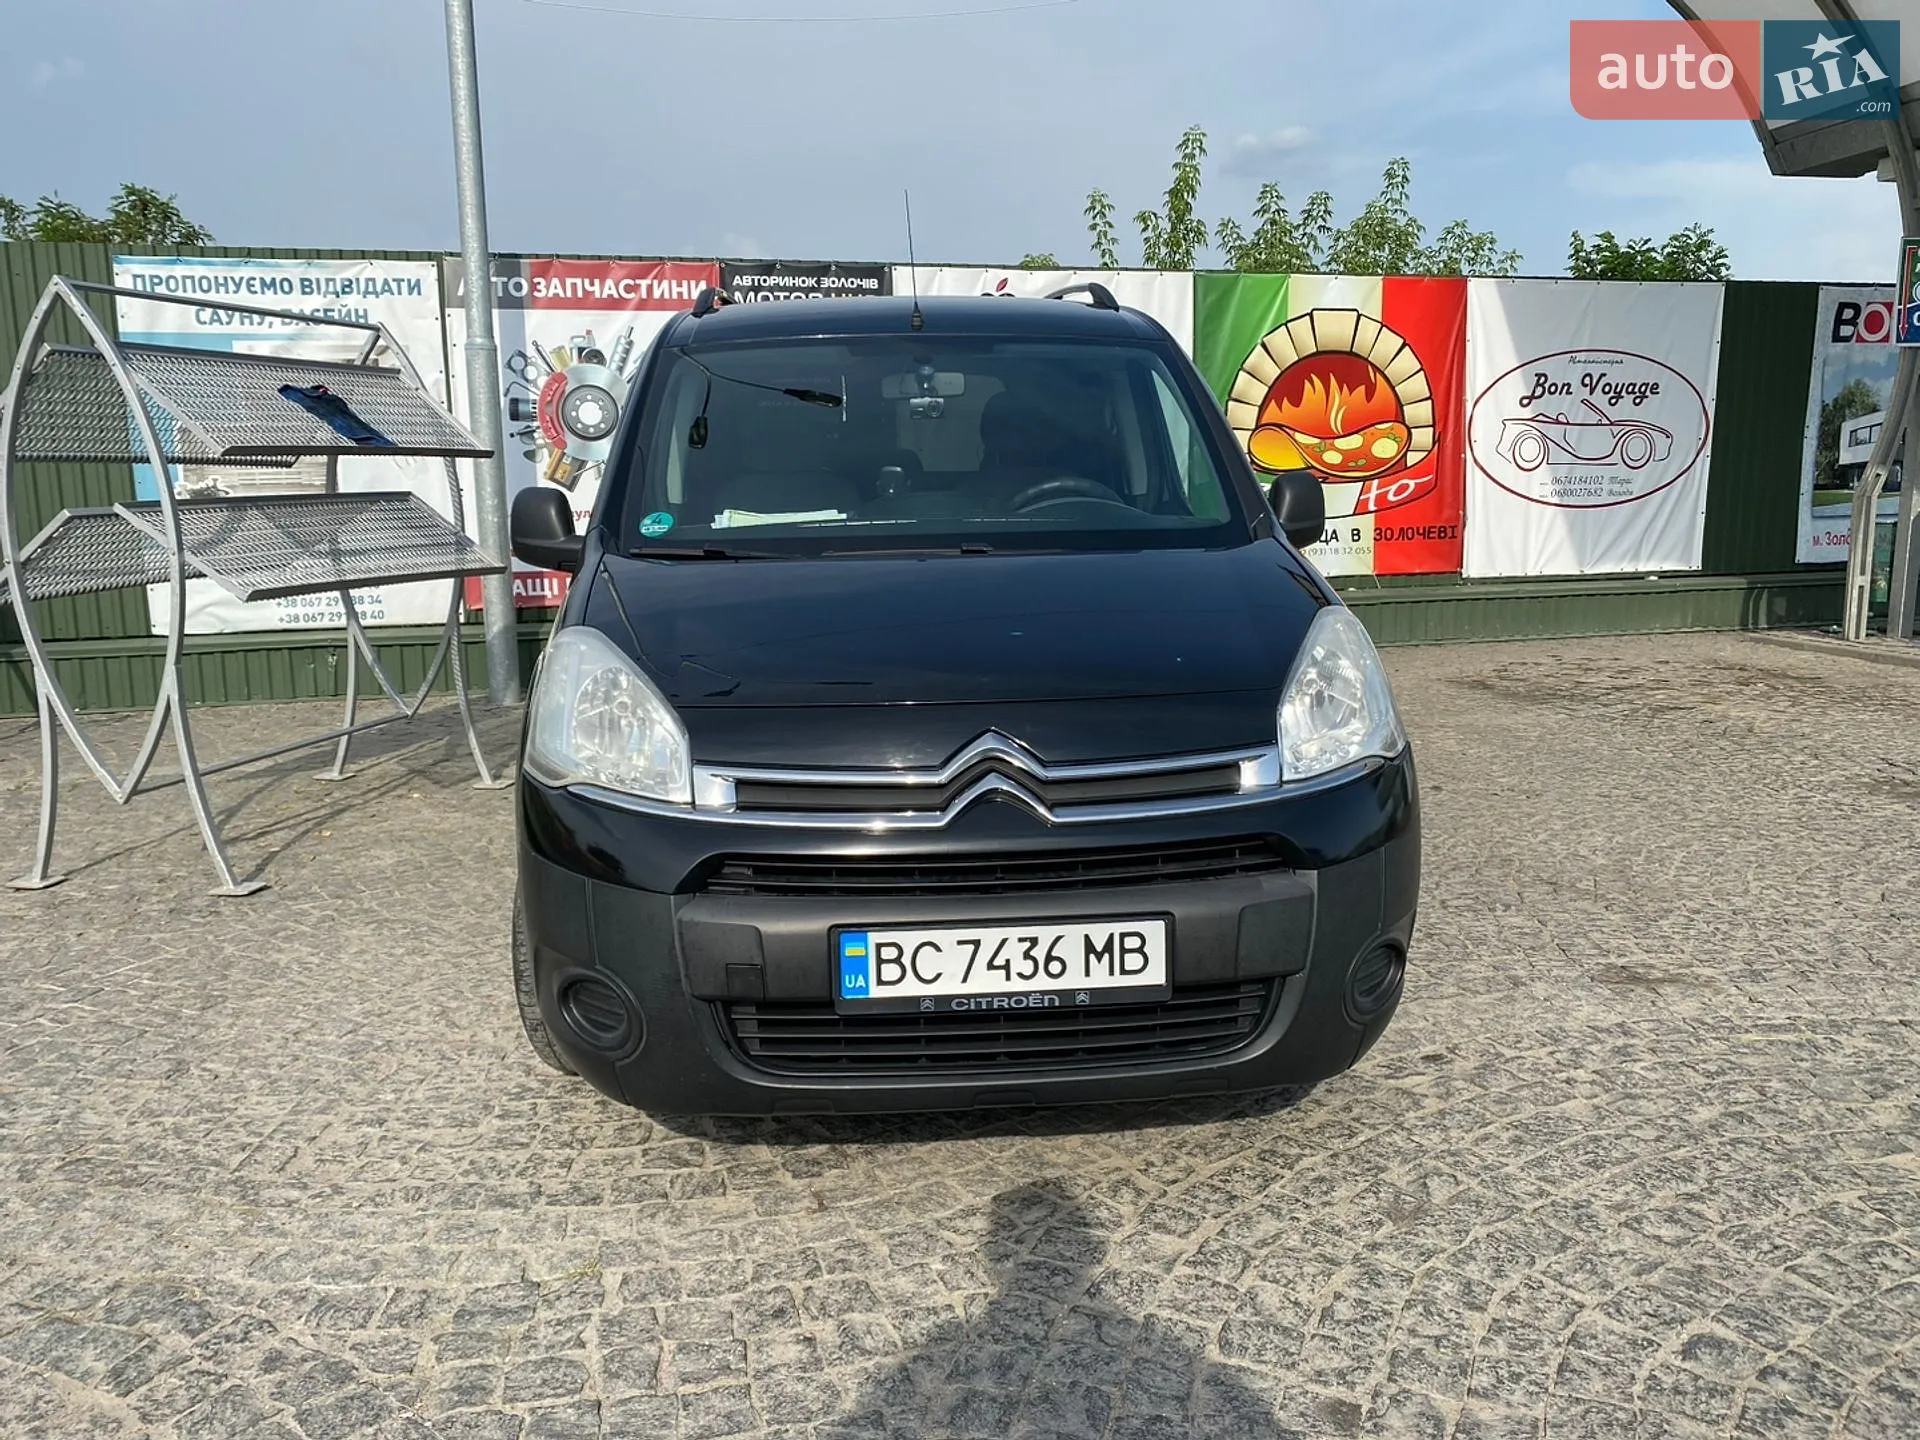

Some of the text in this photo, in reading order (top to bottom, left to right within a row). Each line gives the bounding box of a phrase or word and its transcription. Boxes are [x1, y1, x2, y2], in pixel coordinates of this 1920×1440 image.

[131, 273, 422, 299] ПРОПОНУЄМО ВІДВІДАТИ
[532, 277, 707, 300] ЗАПЧАСТИНИ
[732, 275, 879, 289] АВТОРИНОК ЗОЛОЧІВ
[194, 307, 274, 329] САУНУ,
[1519, 372, 1661, 408] Bon Voyage
[1351, 528, 1361, 543] В
[1373, 525, 1459, 542] ЗОЛОЧЕВІ
[275, 597, 297, 608] +38
[301, 597, 321, 607] 067
[367, 594, 382, 605] 34
[278, 614, 300, 623] +38
[302, 613, 324, 623] 067
[370, 610, 385, 620] 40
[874, 930, 1150, 987] BC 7436 MB
[845, 975, 866, 989] UA
